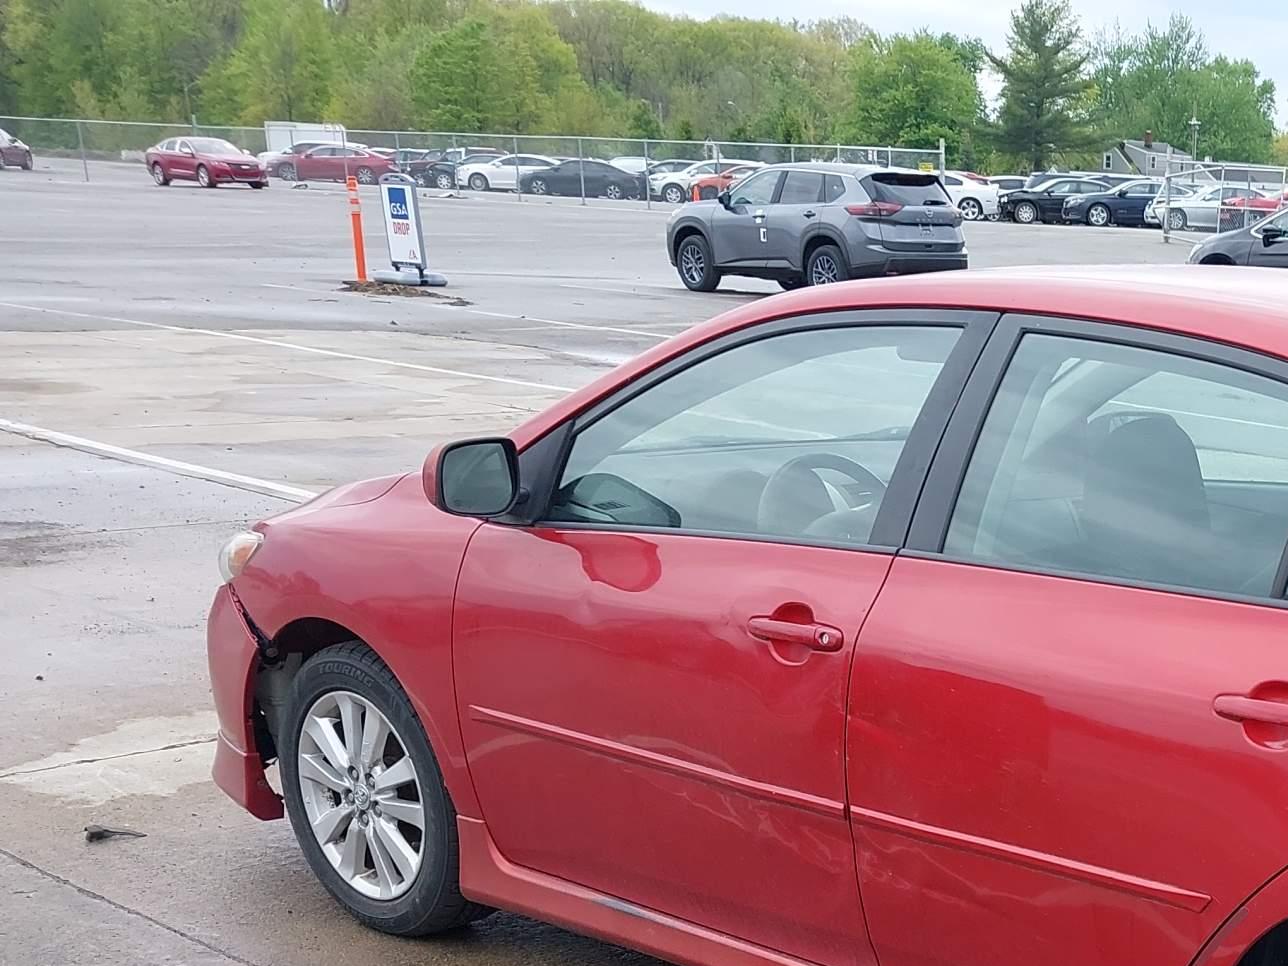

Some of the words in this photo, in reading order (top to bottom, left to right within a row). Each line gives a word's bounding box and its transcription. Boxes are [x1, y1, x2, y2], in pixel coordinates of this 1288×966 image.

[390, 202, 408, 215] GSA
[392, 222, 410, 236] DROP
[318, 662, 375, 688] TOURING
